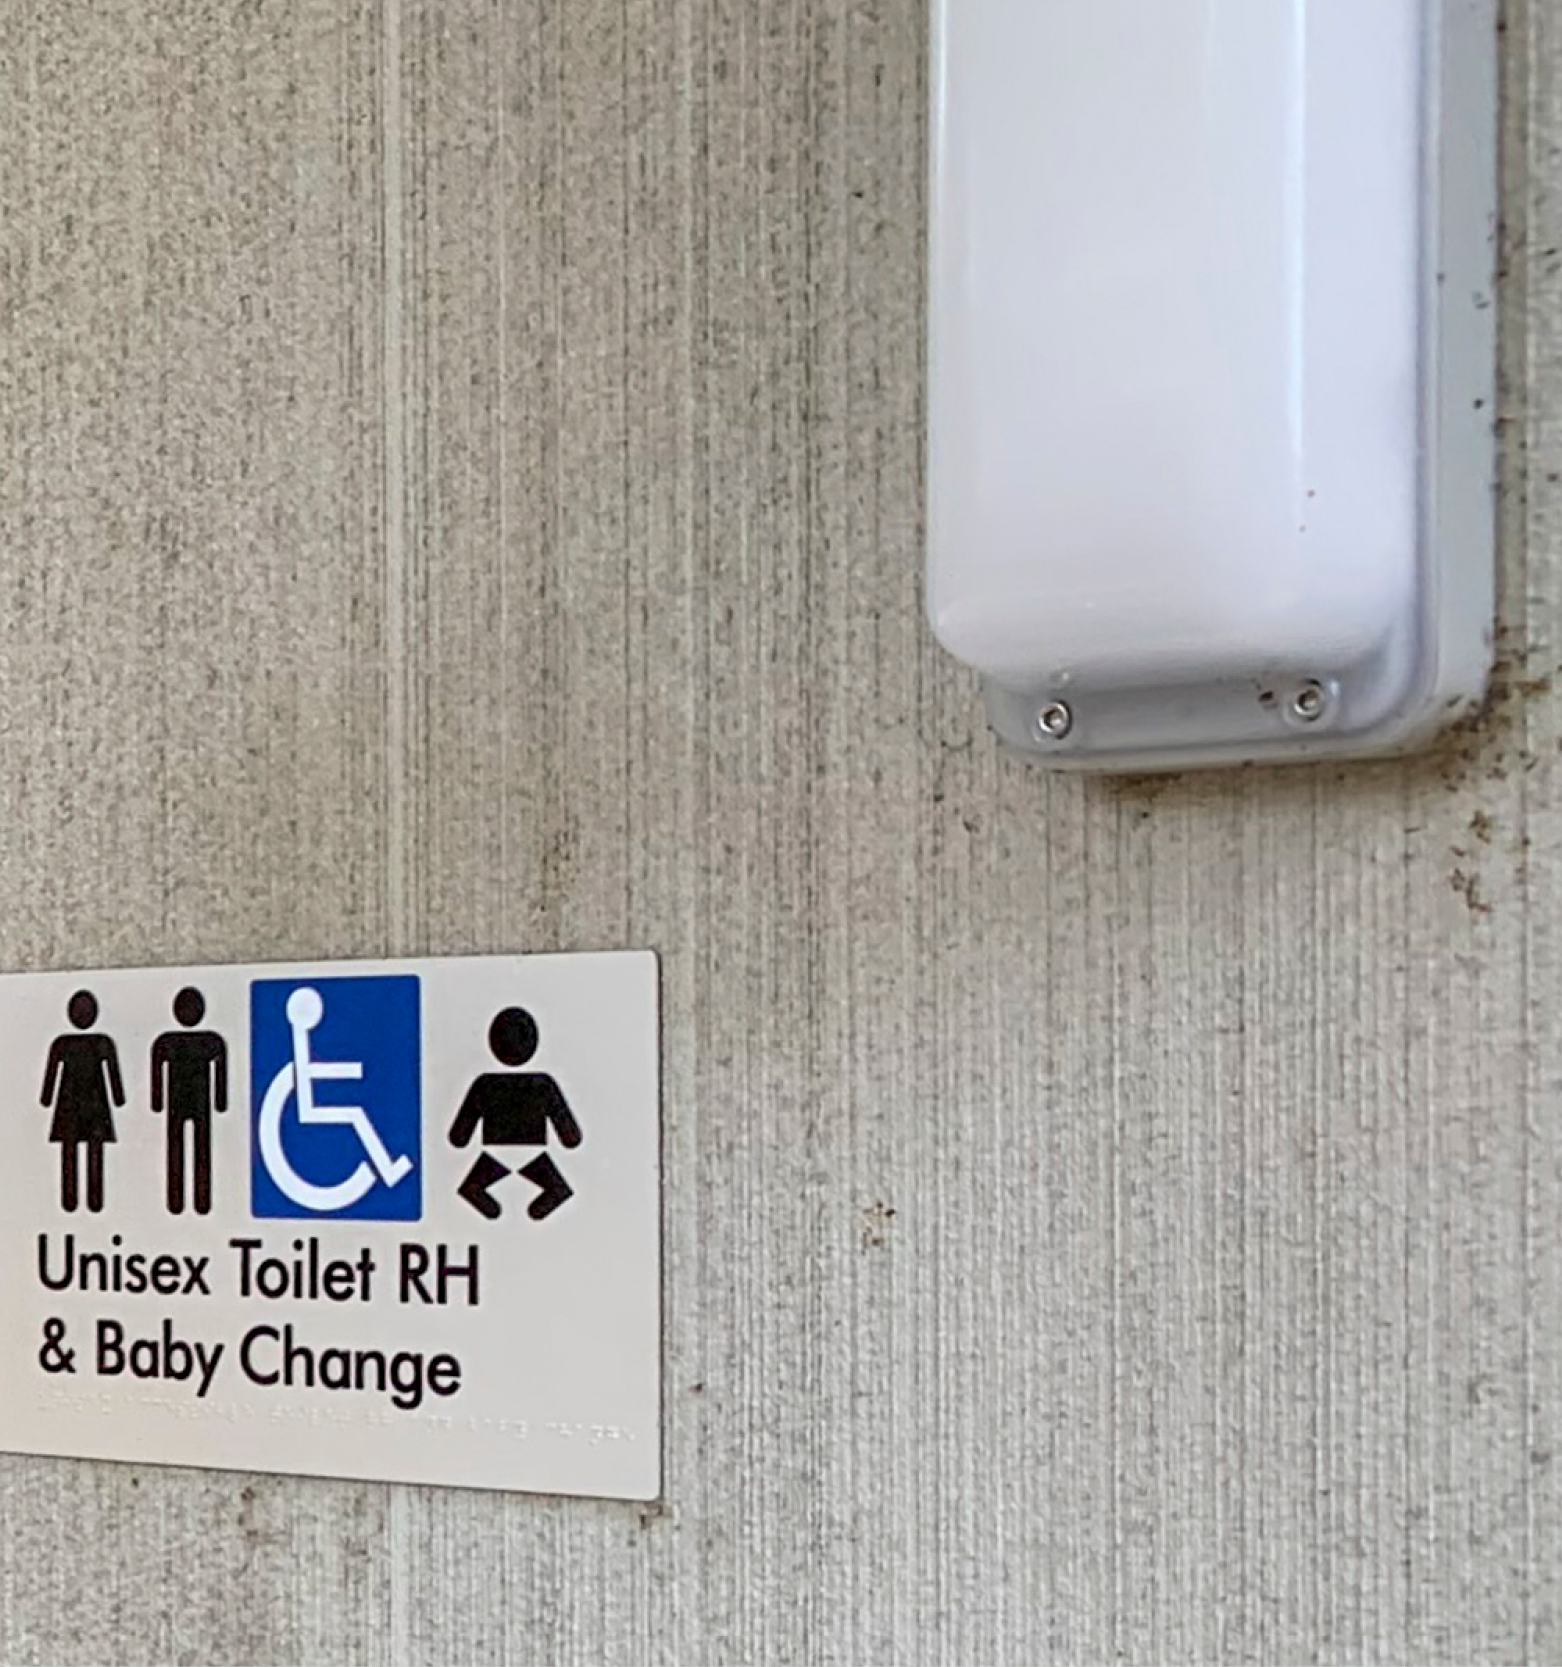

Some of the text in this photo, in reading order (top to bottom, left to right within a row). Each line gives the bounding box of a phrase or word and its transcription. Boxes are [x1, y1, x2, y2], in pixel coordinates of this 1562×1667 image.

[38, 1233, 479, 1306] Unisex Toilet RH
[38, 1317, 462, 1411] & Baby Change
